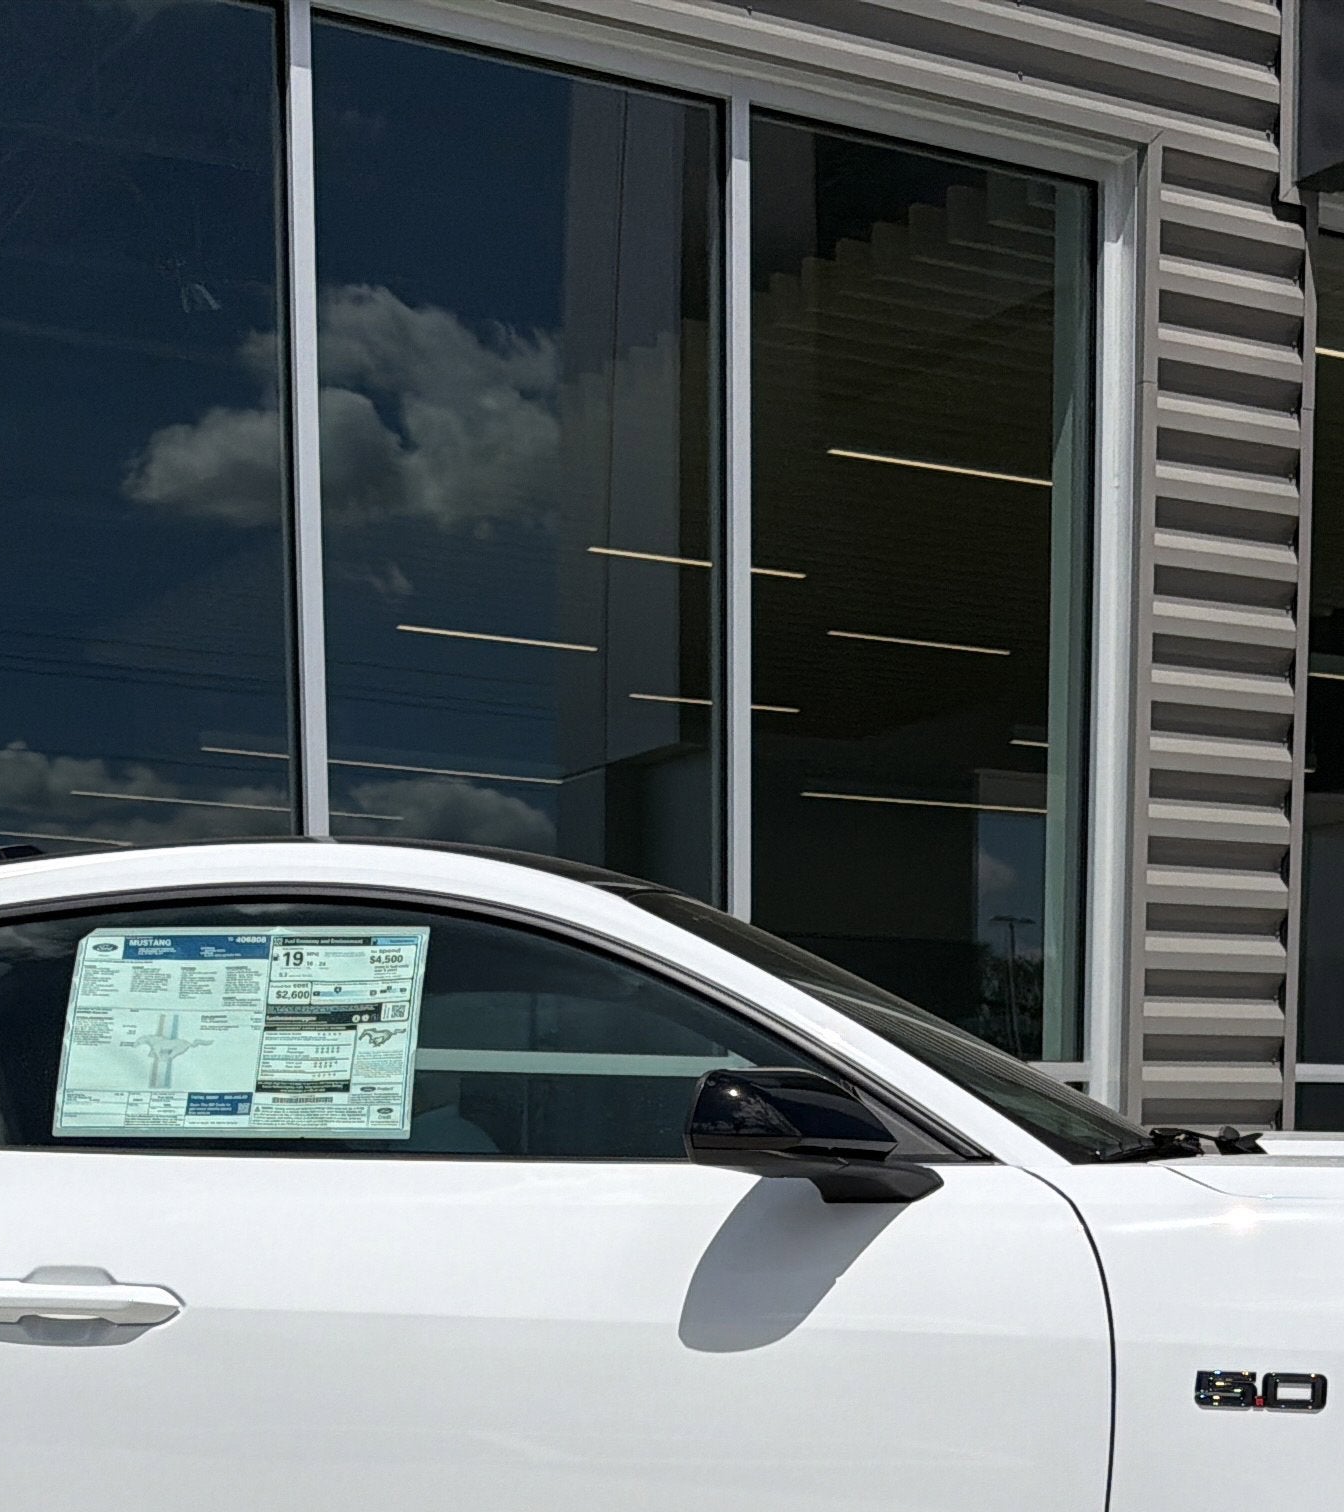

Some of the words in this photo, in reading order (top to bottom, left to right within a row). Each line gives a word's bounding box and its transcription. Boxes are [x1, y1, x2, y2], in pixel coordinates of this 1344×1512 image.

[128, 938, 172, 947] MUSTANG
[282, 951, 304, 967] 19
[369, 954, 404, 965] $4,500
[275, 990, 310, 1000] $2,600
[1194, 1370, 1328, 1412] 5.0
